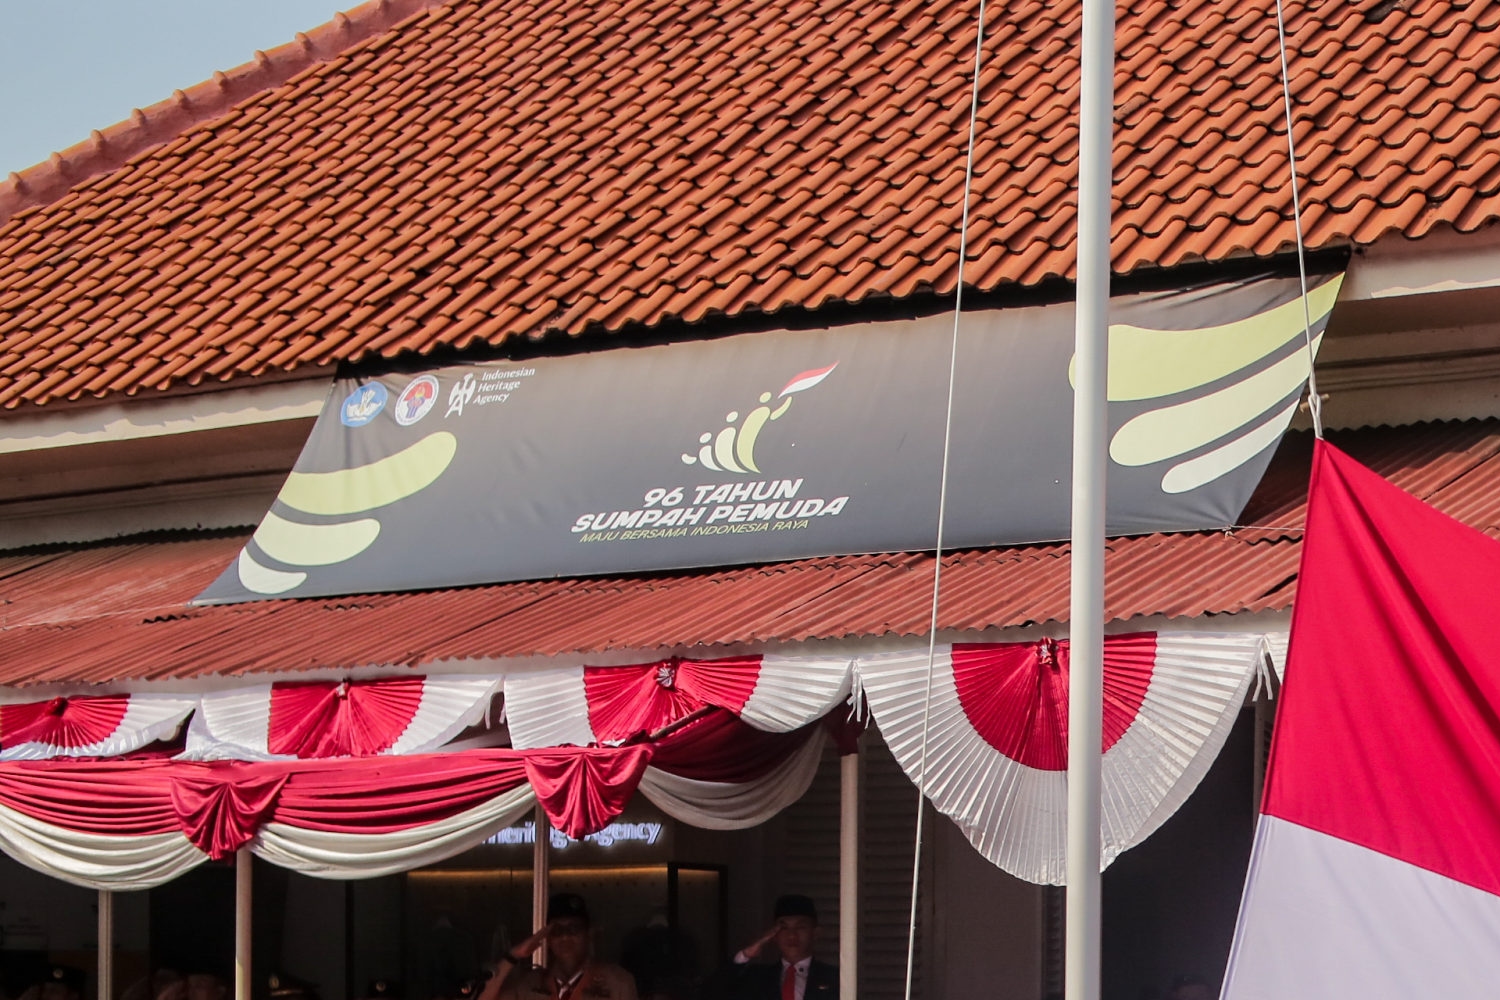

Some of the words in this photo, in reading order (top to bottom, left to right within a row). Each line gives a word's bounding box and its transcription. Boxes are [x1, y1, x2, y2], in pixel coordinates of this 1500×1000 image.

[482, 367, 535, 381] Indonesian
[477, 380, 521, 393] Heritage
[473, 392, 510, 405] Agency
[643, 486, 685, 508] 96
[694, 478, 804, 505] TAHUN
[571, 506, 707, 533] SUMPAH
[706, 496, 850, 525] PEMUDA
[579, 531, 618, 543] MAJU
[620, 527, 688, 541] BERSAMA
[690, 522, 769, 536] INDONESIA
[772, 519, 809, 531] RAYA
